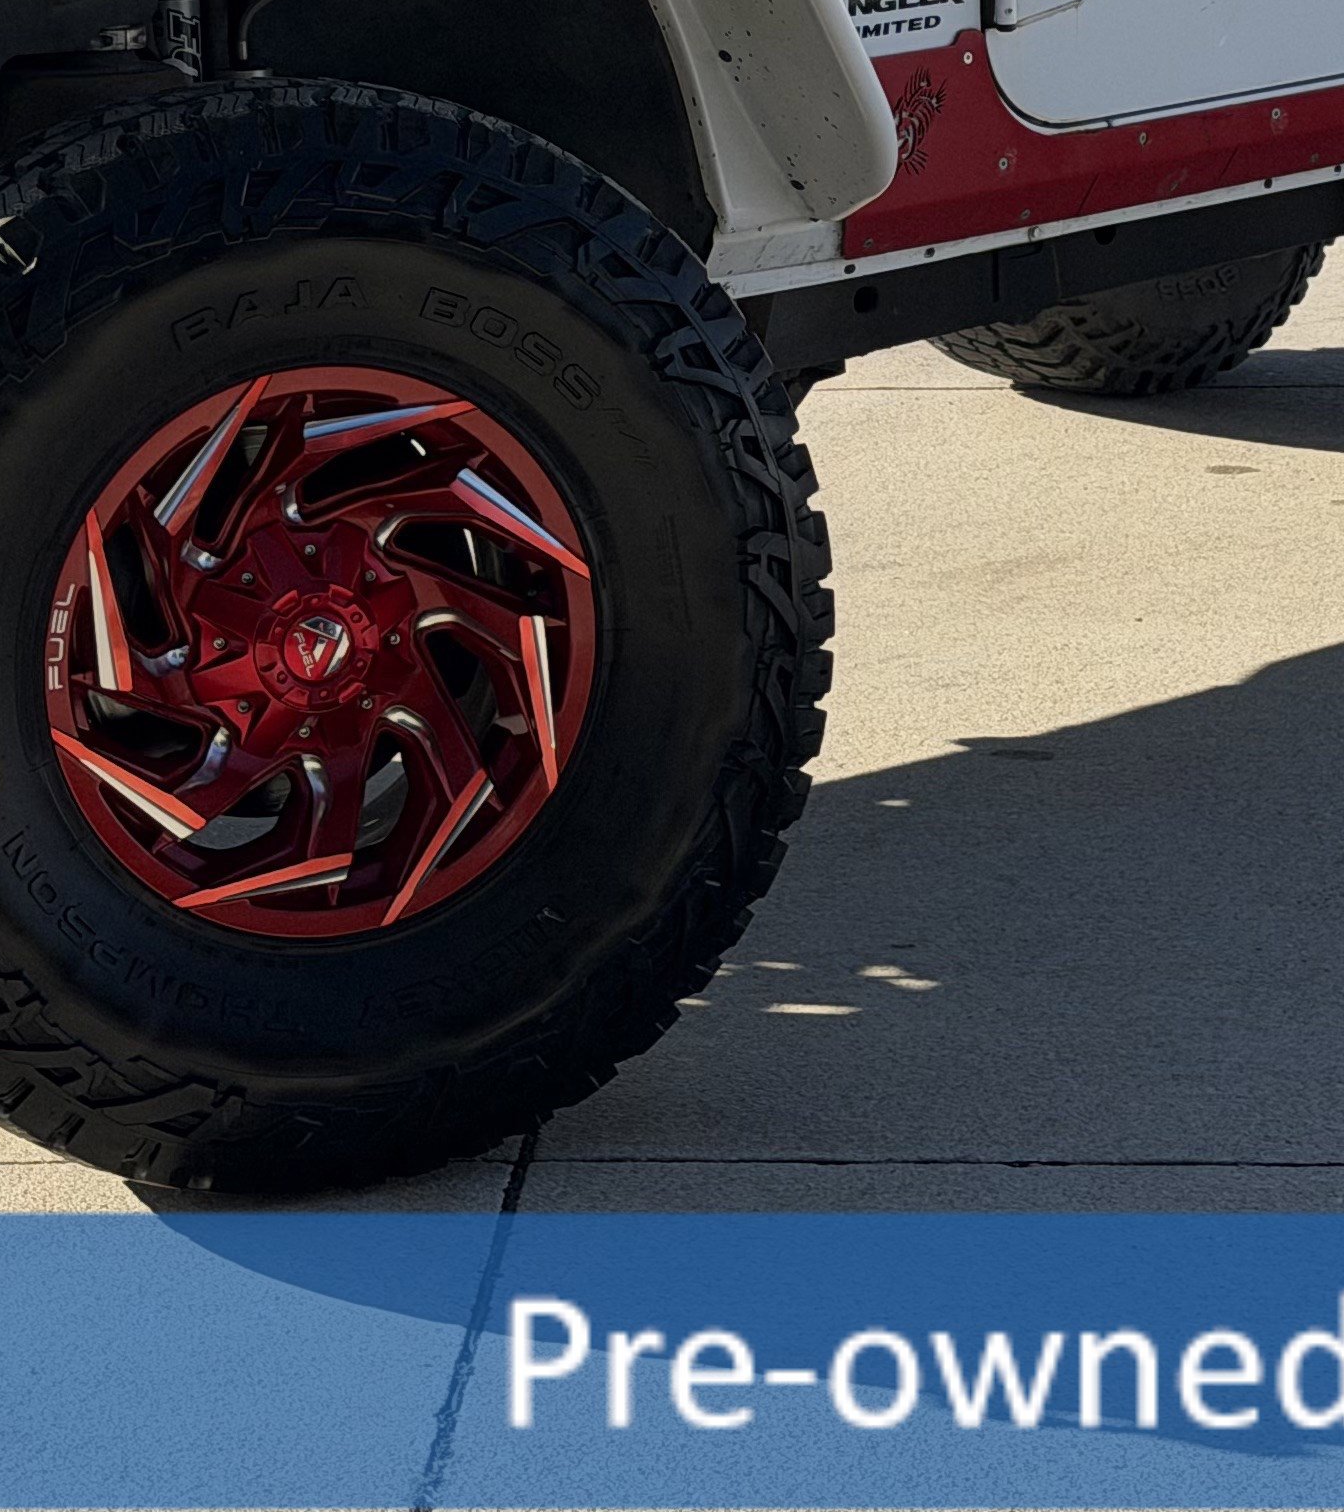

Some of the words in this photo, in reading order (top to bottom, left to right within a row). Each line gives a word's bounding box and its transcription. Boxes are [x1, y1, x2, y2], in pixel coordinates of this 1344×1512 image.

[855, 15, 942, 39] IMITED
[170, 275, 370, 352] BAJA
[418, 286, 602, 411] BOSS
[47, 582, 76, 691] FUEL
[292, 631, 315, 678] FUEL
